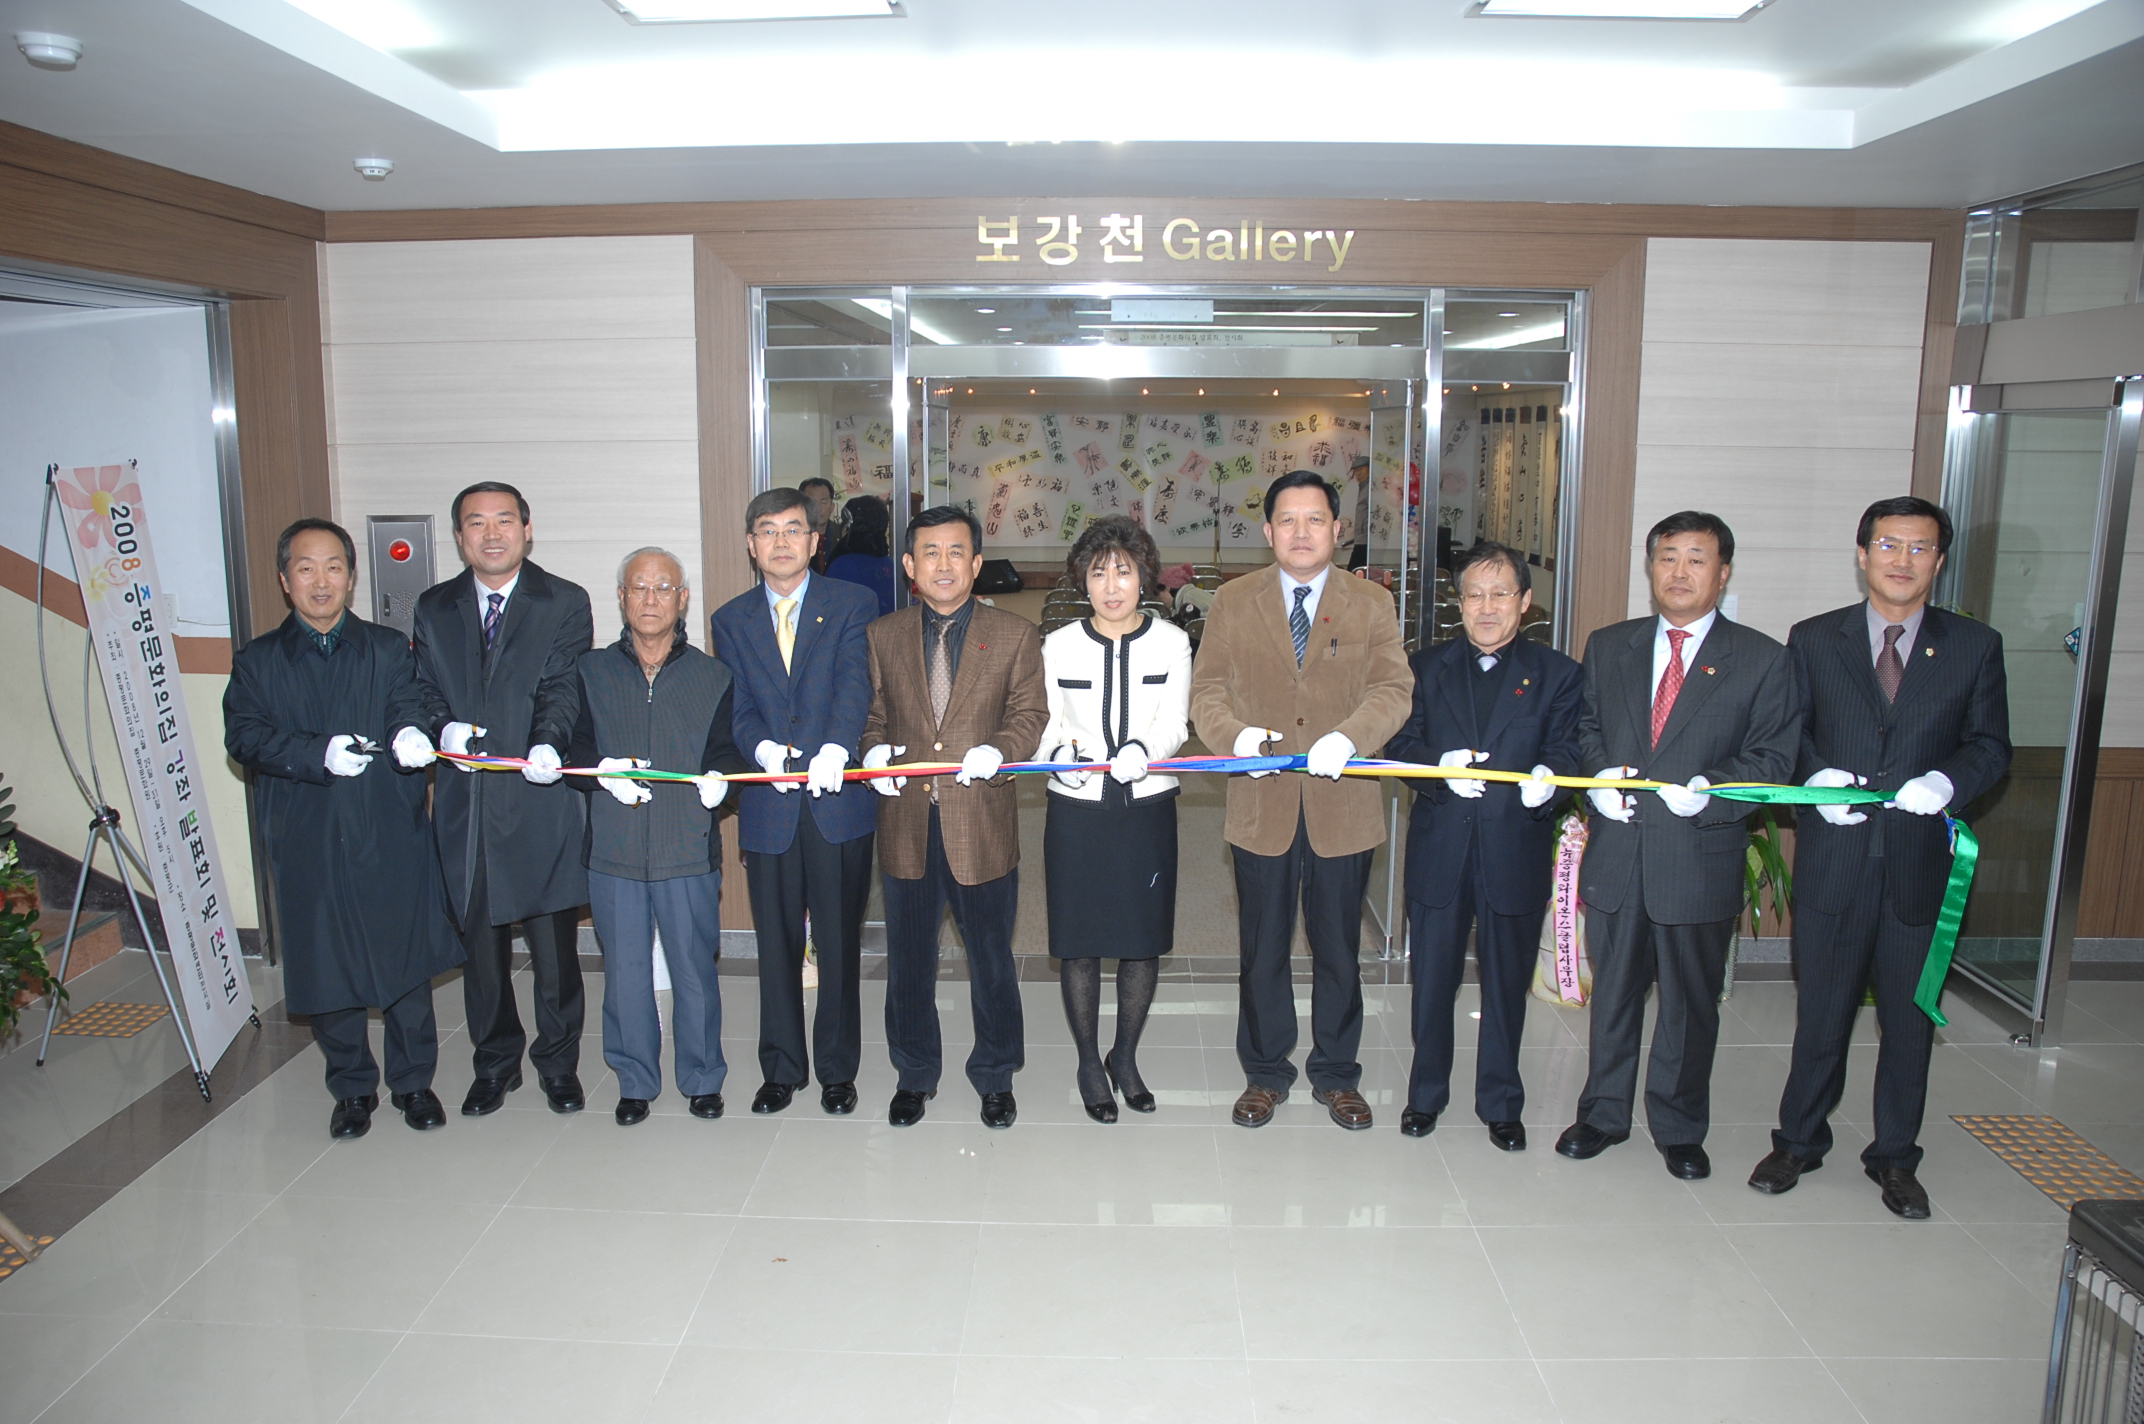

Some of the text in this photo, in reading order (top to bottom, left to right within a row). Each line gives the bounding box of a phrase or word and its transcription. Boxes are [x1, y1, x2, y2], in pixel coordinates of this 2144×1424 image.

[976, 213, 1355, 273] 보강천 Gallery
[110, 505, 239, 1005] 2008 증평문화의집 강좌 발표회 및 전시회
